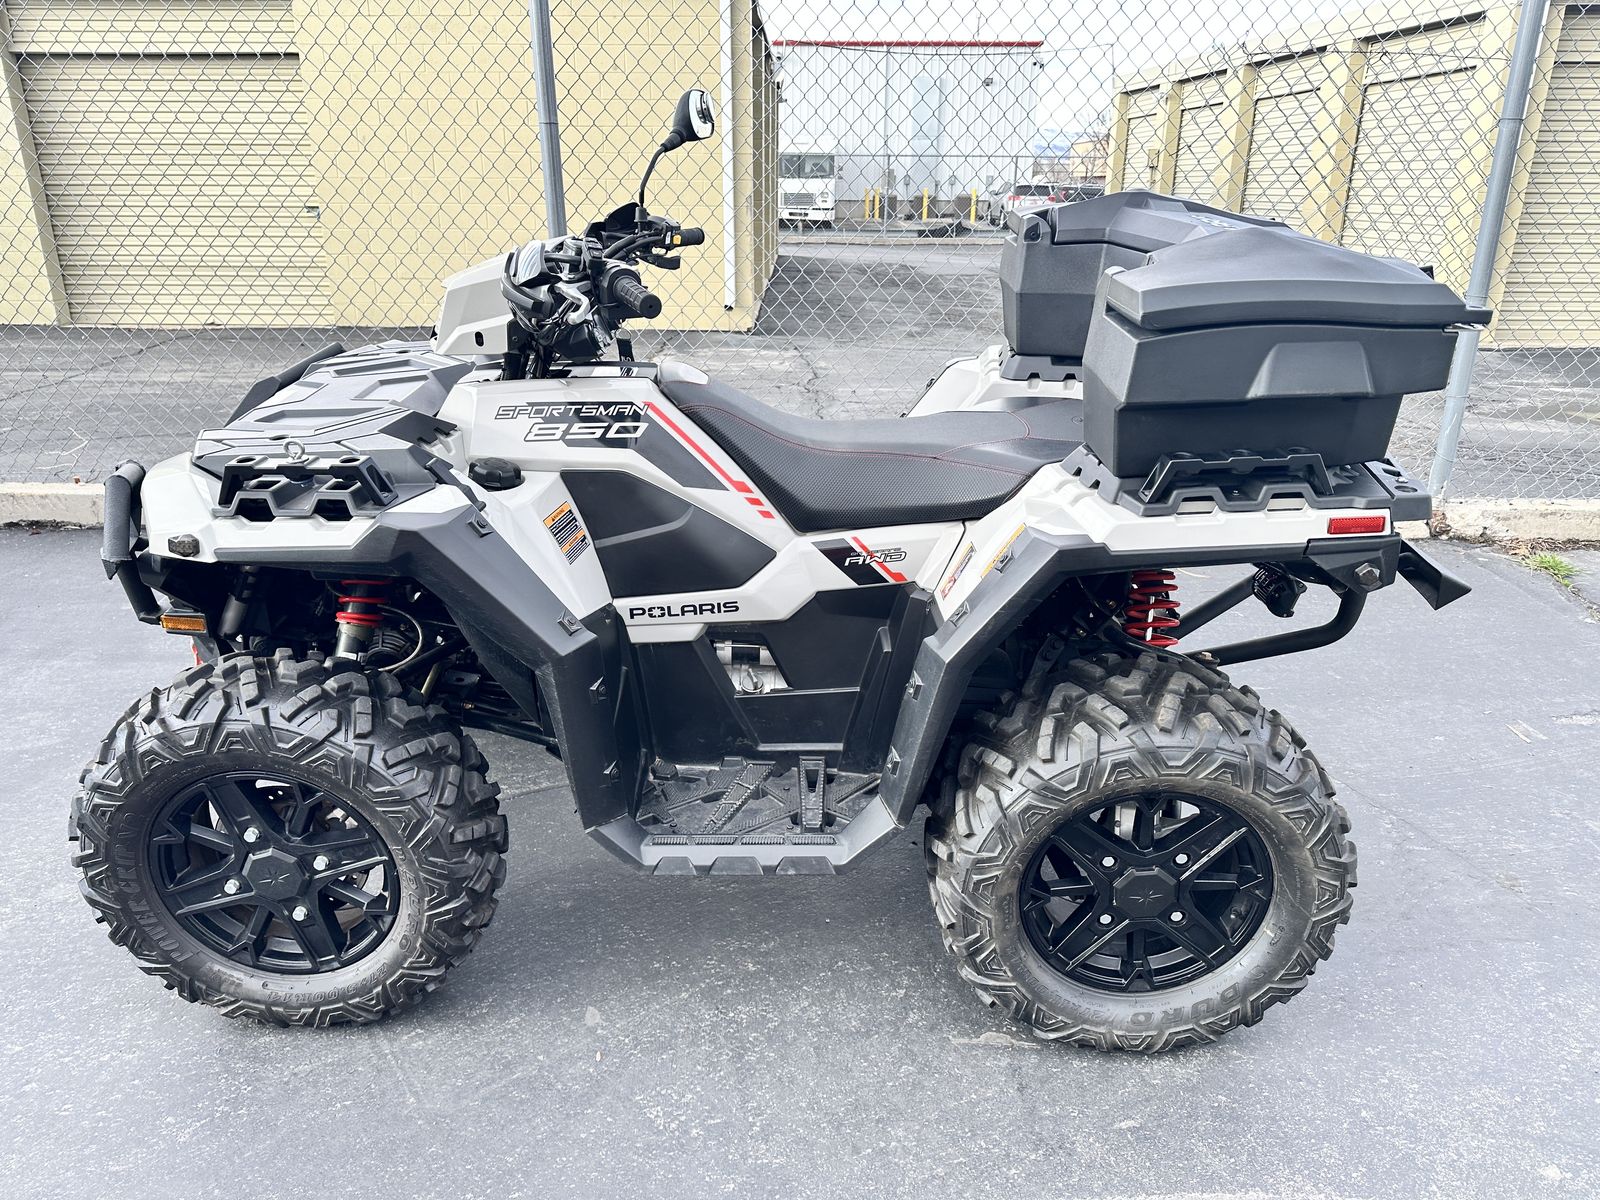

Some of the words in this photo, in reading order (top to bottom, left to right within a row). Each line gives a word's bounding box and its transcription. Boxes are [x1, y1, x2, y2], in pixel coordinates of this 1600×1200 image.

[495, 403, 649, 420] SPORTSMAN
[524, 422, 649, 442] 850
[844, 551, 907, 567] AWD
[629, 601, 739, 619] POLARIS
[1129, 982, 1241, 1025] DURO
